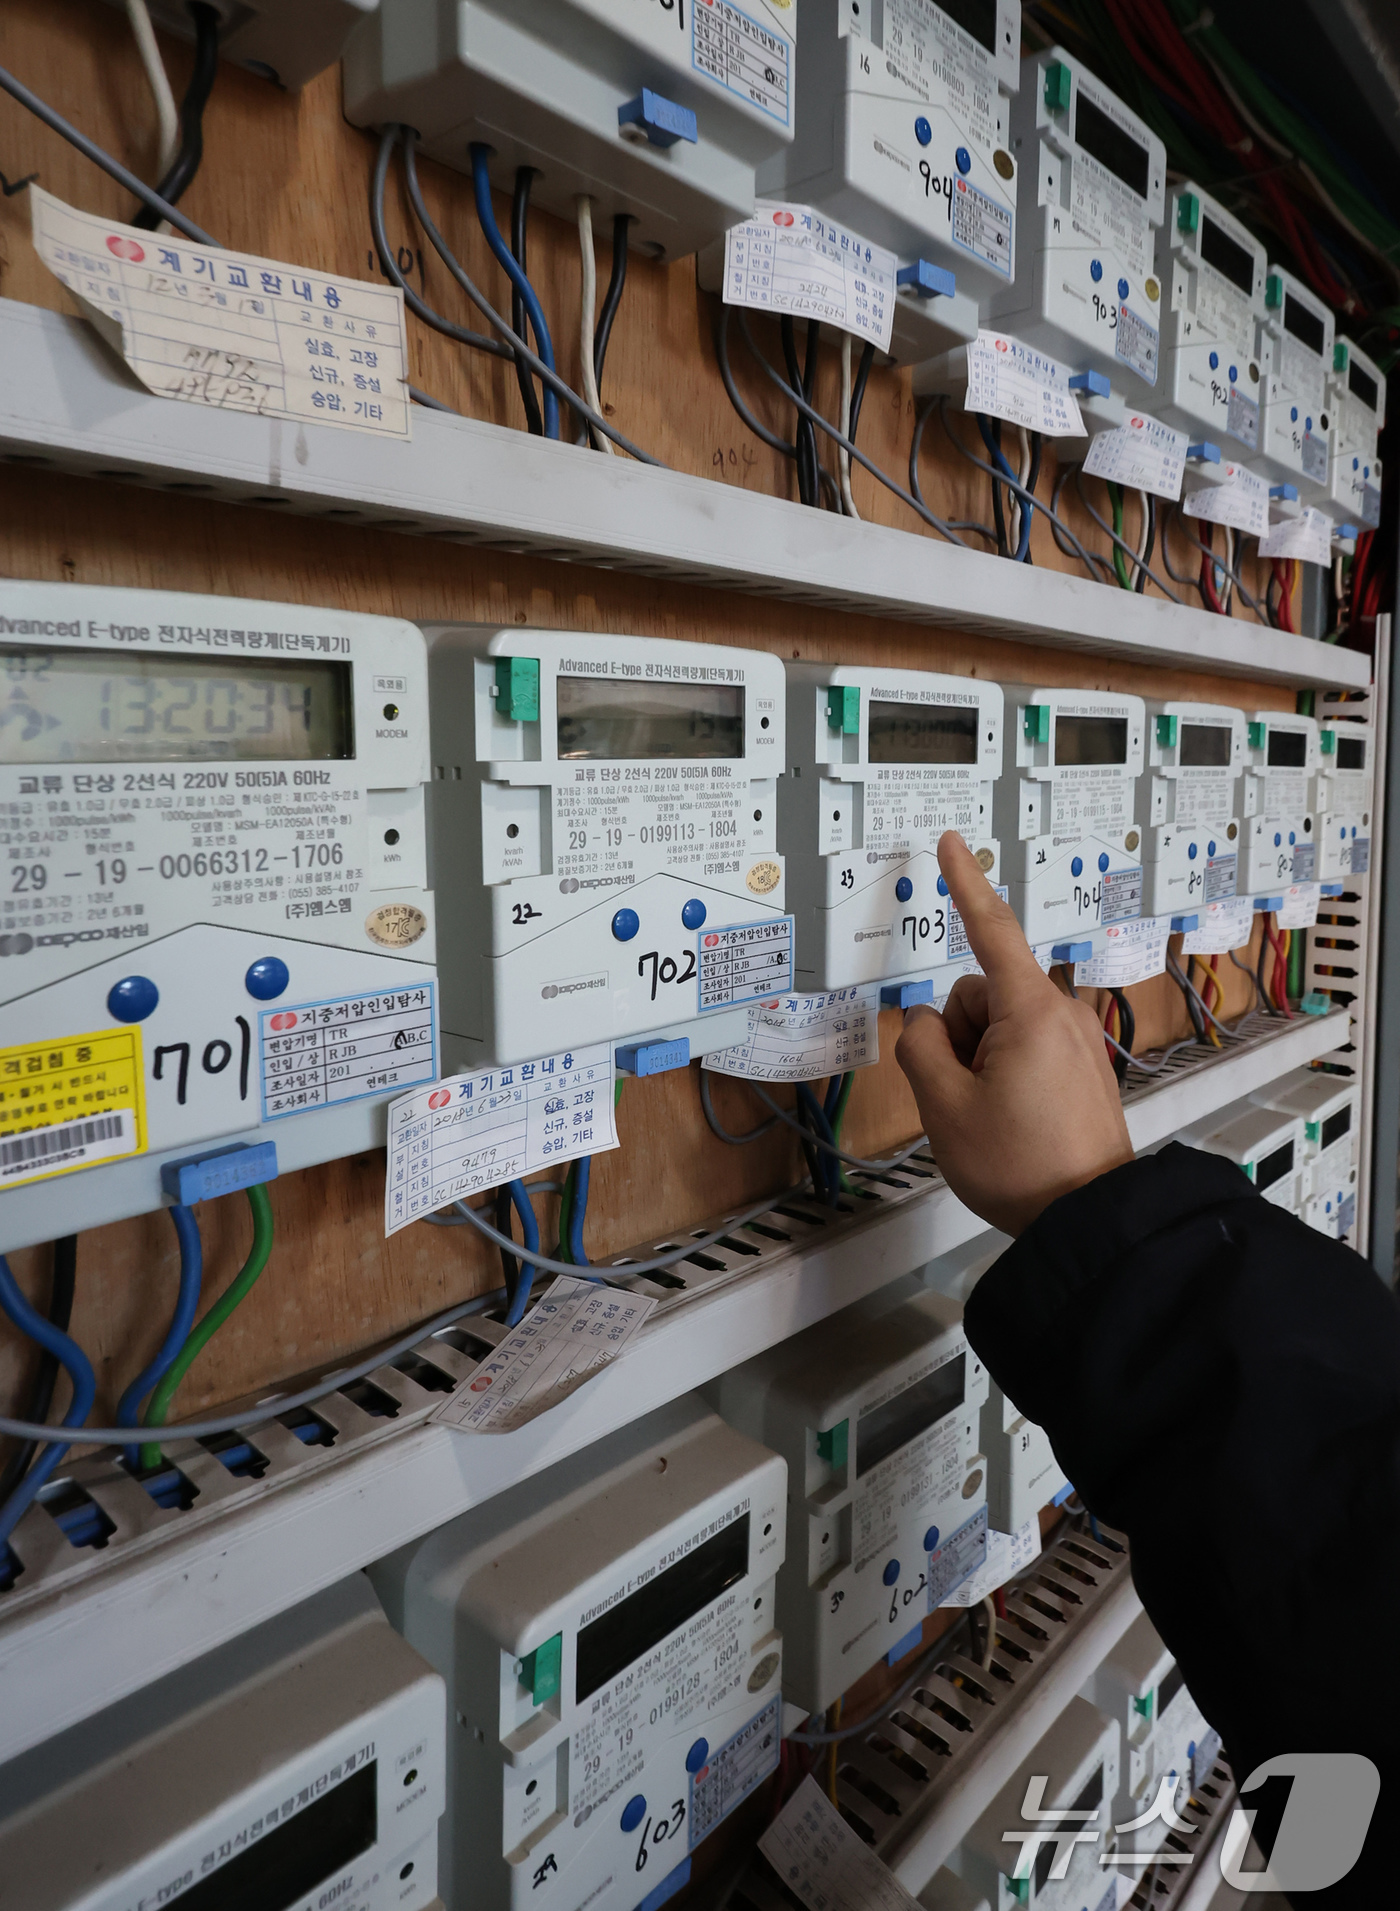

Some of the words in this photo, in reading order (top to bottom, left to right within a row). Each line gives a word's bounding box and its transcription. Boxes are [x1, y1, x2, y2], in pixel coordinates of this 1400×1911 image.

[860, 53, 870, 75] 16
[919, 160, 953, 222] 904
[1092, 293, 1118, 330] 903
[349, 347, 379, 368] 고장
[308, 364, 346, 386] 신규,
[353, 372, 382, 394] 증설
[353, 400, 384, 421] 기타
[87, 620, 150, 643] E-type
[558, 658, 608, 674] Advanced
[610, 661, 642, 677] E-type
[870, 687, 899, 699] Advanced
[900, 689, 919, 701] E-type
[375, 728, 408, 739] MODEM
[756, 737, 775, 745] MODEM
[19, 775, 64, 795] 교류
[72, 773, 116, 794] 단상
[123, 772, 176, 791] 2선식
[183, 772, 229, 789] 220V
[293, 770, 332, 786] 60Hz
[574, 768, 597, 782] 교류
[600, 767, 621, 782] 단상
[624, 766, 651, 781] 2선식
[654, 767, 678, 779] 220V
[680, 766, 709, 779] 50(5)A
[711, 765, 732, 778] 60Hz
[587, 796, 630, 806] 1000pulse/kWh
[567, 818, 588, 828] 제조사
[872, 816, 884, 831] 29
[894, 815, 904, 830] 19
[913, 813, 947, 828] 0199114
[954, 811, 972, 825] 1804
[569, 830, 587, 850] 29
[606, 828, 622, 847] 19
[640, 822, 695, 844] 0199113
[709, 819, 738, 838] 1804
[382, 852, 402, 864] kWh
[720, 849, 745, 860] 385-4107
[11, 864, 48, 894] 29
[95, 858, 128, 887] 19
[315, 882, 360, 896] 385-4107
[1074, 880, 1102, 921] 704
[512, 902, 543, 925] 22
[720, 923, 788, 945] 지중저압인입탐사
[902, 909, 946, 952] 703
[703, 950, 730, 963] 변압기명
[734, 947, 745, 957] TR
[638, 950, 698, 1001] 702
[703, 966, 716, 977] 인입
[734, 975, 746, 984] 201
[703, 977, 730, 991] 조사일자
[301, 989, 427, 1026] 지중저압인입탐사
[703, 991, 730, 1005] 조사회사
[784, 987, 857, 1012] 계기교환내용
[269, 1033, 318, 1053] 변압기명
[328, 1027, 348, 1041] TR
[153, 1014, 252, 1105] 701
[269, 1057, 293, 1073] 인입
[307, 1052, 319, 1066] 상
[329, 1049, 338, 1060] R
[341, 1044, 357, 1058] JB
[329, 1065, 350, 1079] 201
[458, 1052, 575, 1099] 계기교환내용
[728, 1061, 746, 1071] 번호
[270, 1070, 320, 1092] 조사일자
[366, 1072, 399, 1089] 연테크
[543, 1069, 595, 1092] 교환사유
[272, 1089, 321, 1111] 조사회사
[572, 1089, 595, 1107] 고장
[543, 1118, 568, 1135] 신규,
[572, 1108, 594, 1125] 증설
[396, 1121, 428, 1145] 교환일자
[542, 1137, 568, 1155] 승압,
[571, 1127, 594, 1145] 기타
[579, 1585, 626, 1627] Advanced
[627, 1565, 657, 1593] E-type
[888, 1573, 928, 1624] 602
[664, 1632, 687, 1658] 220V
[584, 1755, 601, 1783] 29
[618, 1727, 634, 1751] 19
[649, 1671, 701, 1726] 0199128
[713, 1639, 740, 1672] 1804
[635, 1798, 686, 1872] 603
